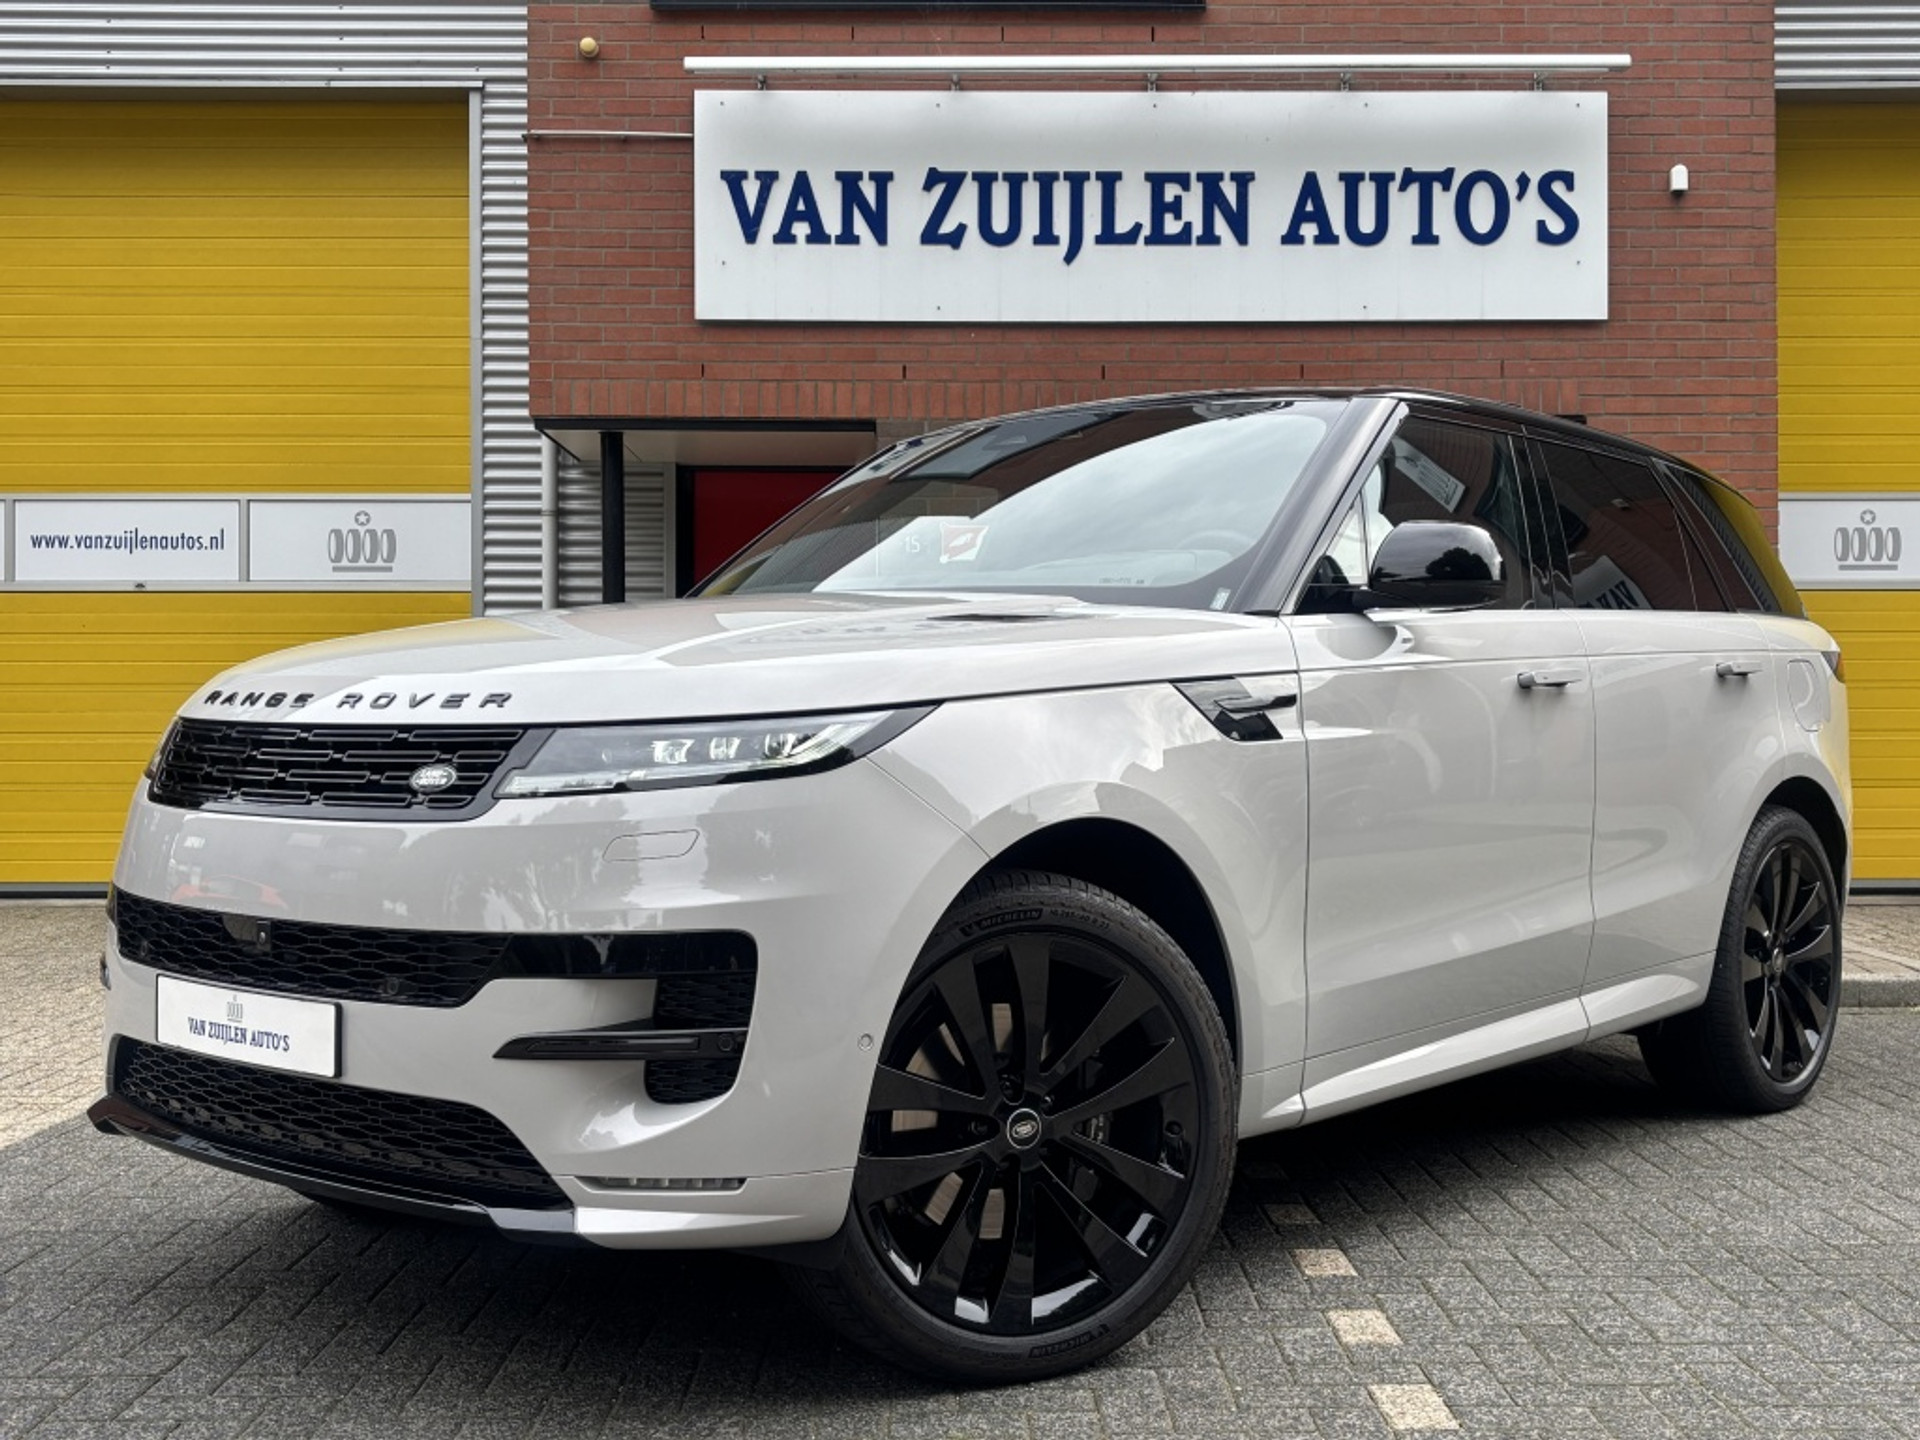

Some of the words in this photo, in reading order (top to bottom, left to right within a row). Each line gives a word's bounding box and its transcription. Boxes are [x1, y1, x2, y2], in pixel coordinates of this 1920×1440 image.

[719, 169, 895, 246] VAN
[920, 166, 1256, 266] ZUIJLEN
[1280, 166, 1580, 248] AUTO'S
[30, 527, 225, 555] www.vanzuijlenautos.nl
[204, 690, 314, 708] RANGE
[336, 692, 512, 709] ROVER
[980, 909, 1042, 929] MICHELIN
[187, 1016, 206, 1036] VAN
[208, 1021, 247, 1046] ZUIJLEN
[249, 1029, 290, 1052] AUTO'S
